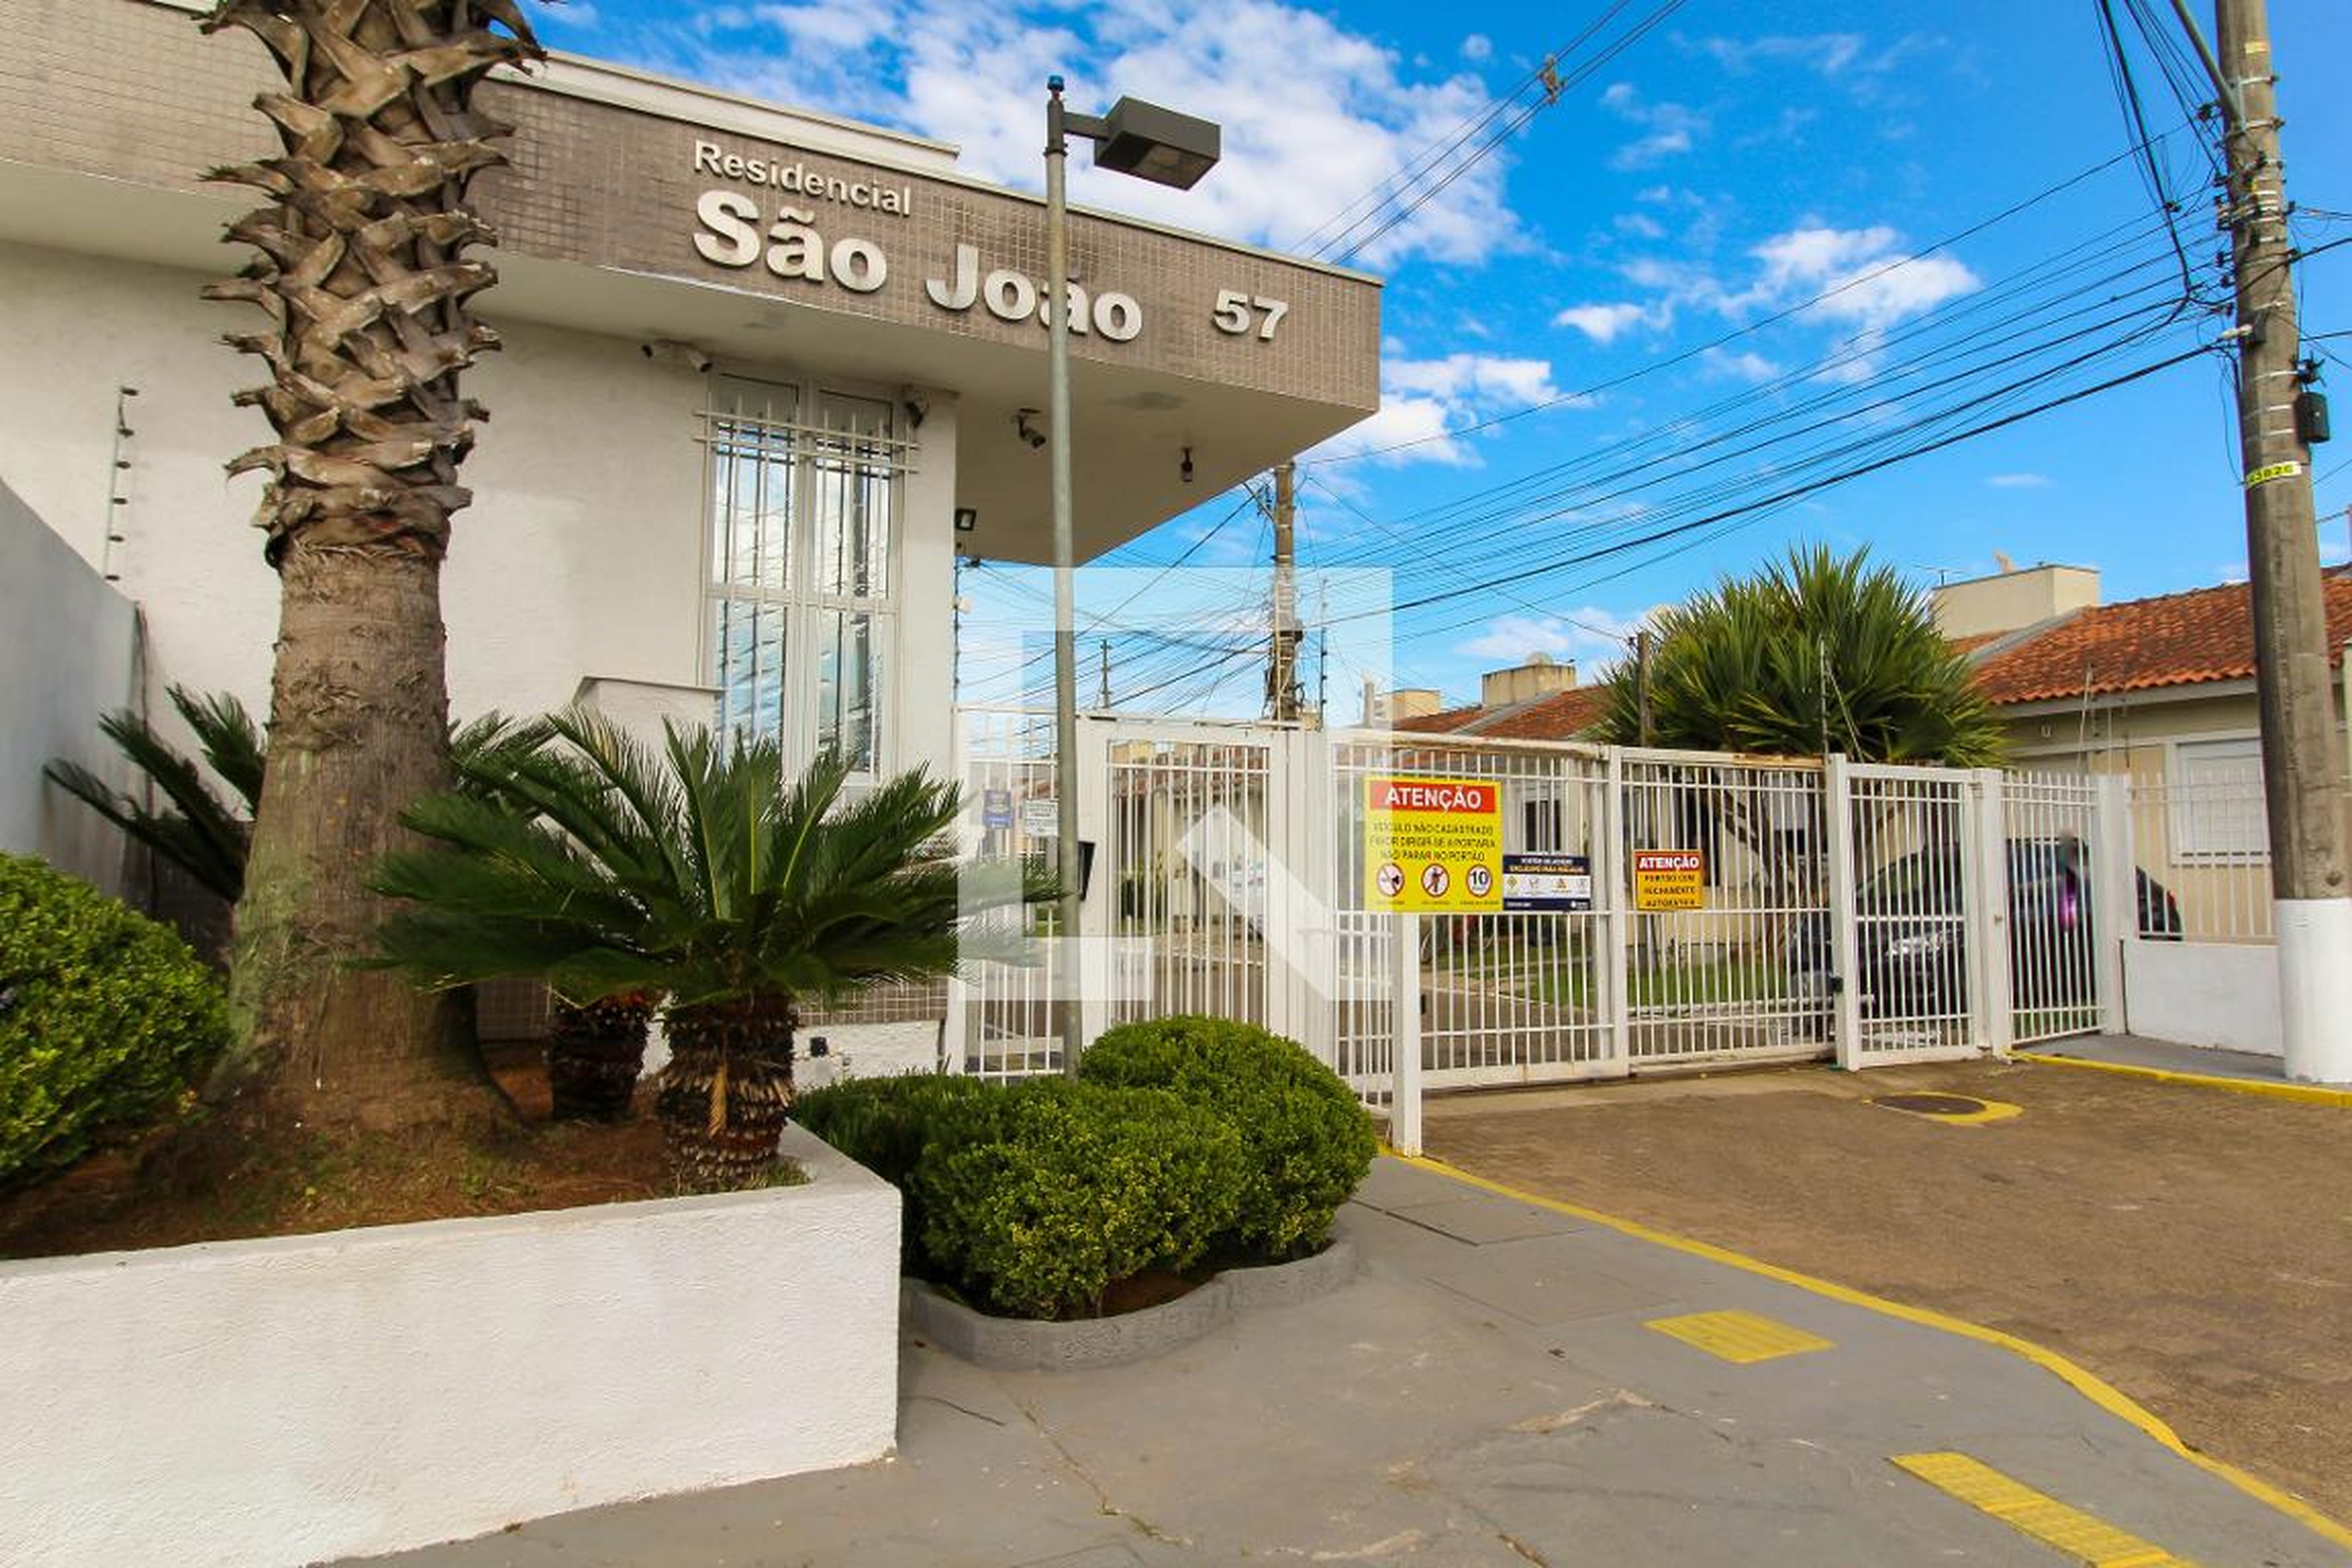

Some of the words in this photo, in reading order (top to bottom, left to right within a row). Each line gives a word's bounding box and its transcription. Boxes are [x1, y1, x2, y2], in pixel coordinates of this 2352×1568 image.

[695, 140, 911, 217] Residencial
[693, 190, 888, 293] São
[1213, 289, 1289, 341] 57
[1386, 785, 1482, 812] ATENÇÃO
[1639, 854, 1699, 871] ATENÇÃO
[1470, 870, 1488, 885] 10
